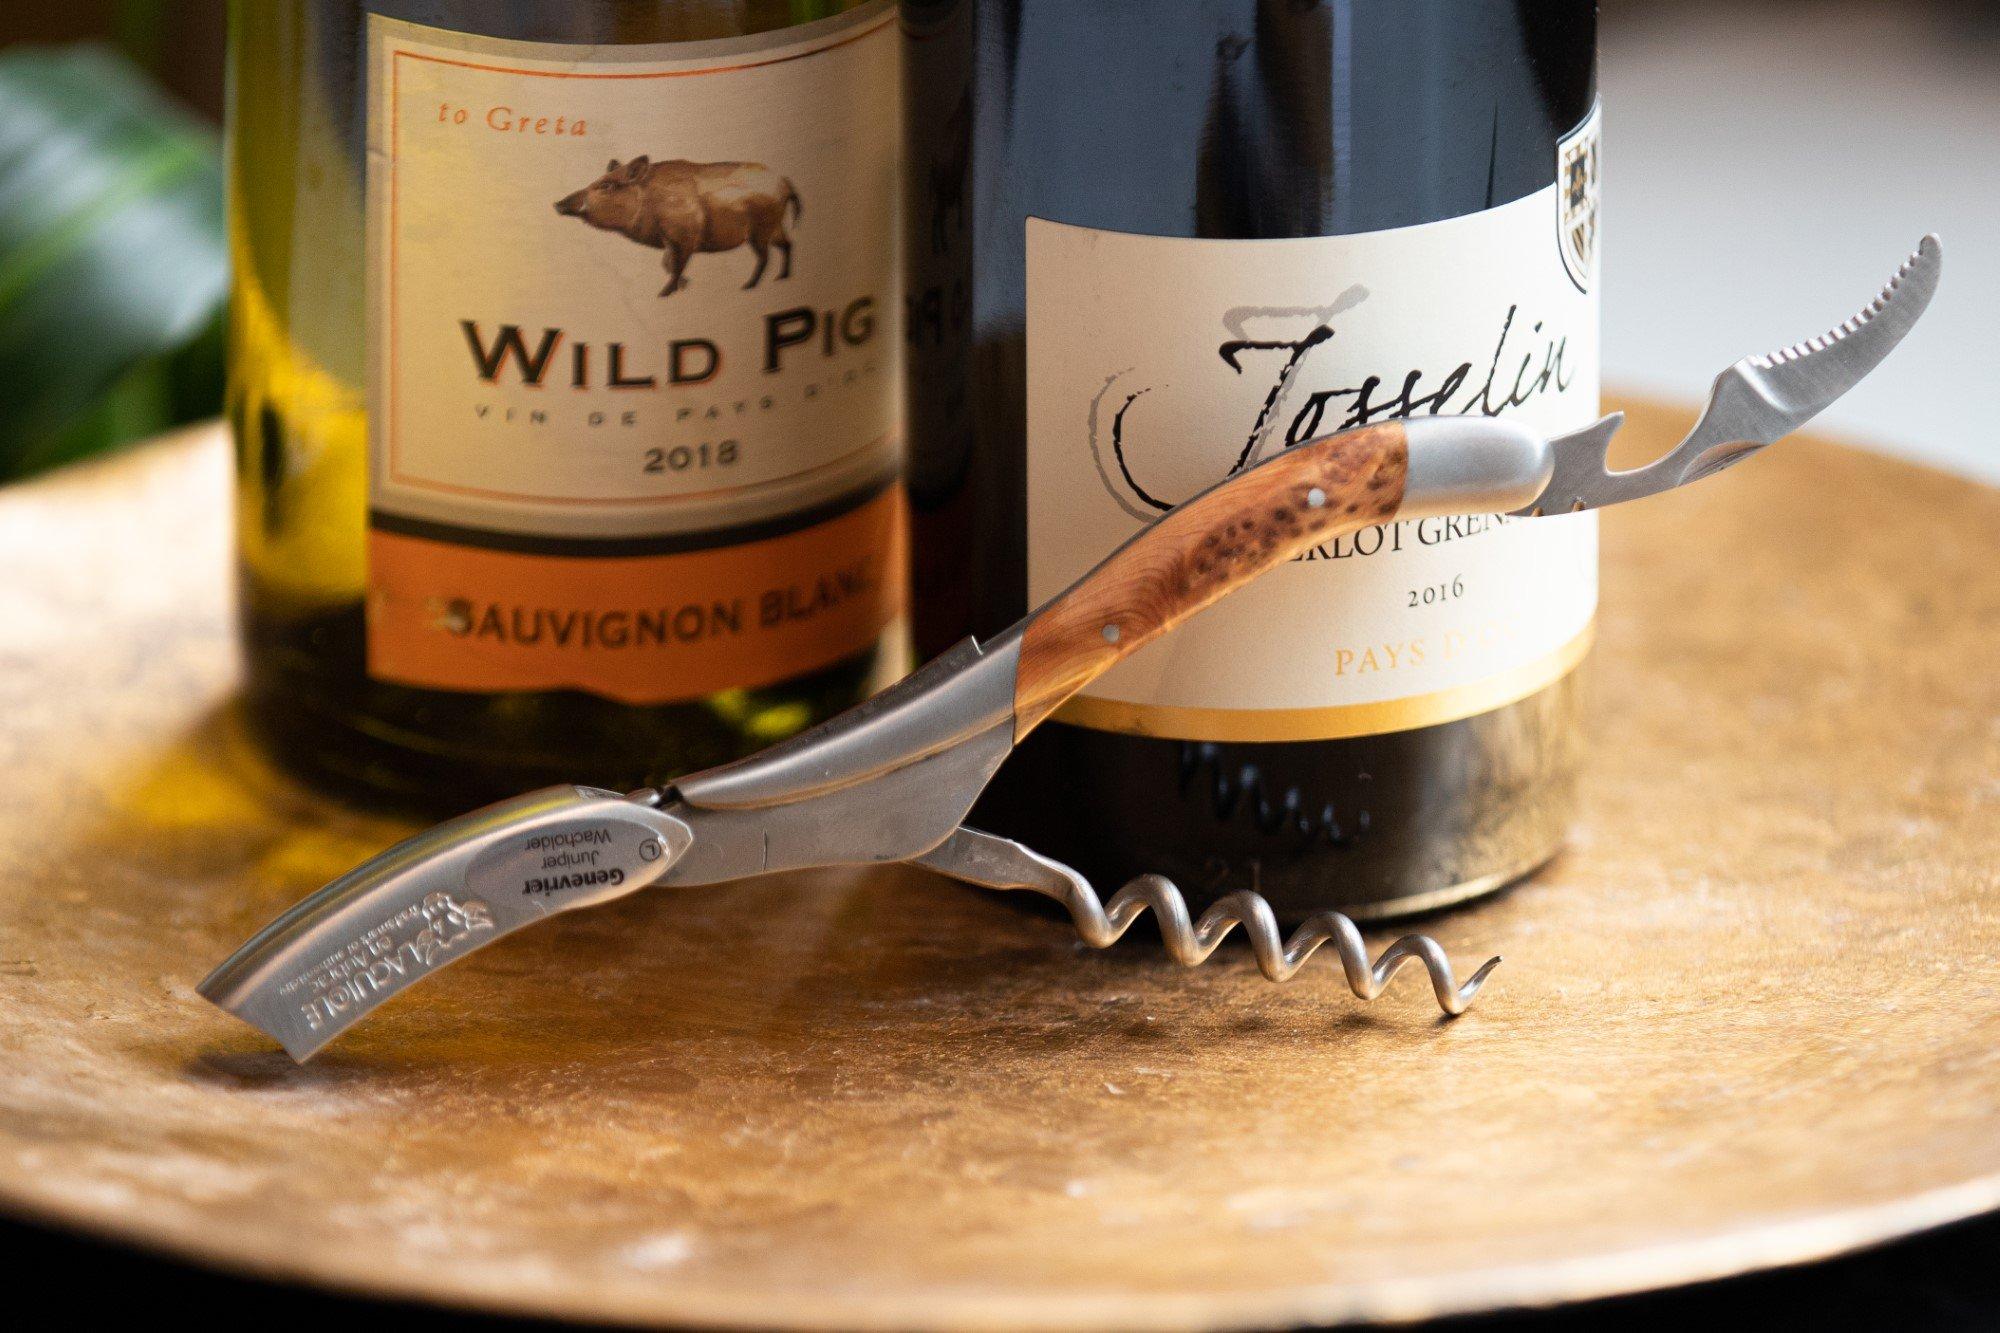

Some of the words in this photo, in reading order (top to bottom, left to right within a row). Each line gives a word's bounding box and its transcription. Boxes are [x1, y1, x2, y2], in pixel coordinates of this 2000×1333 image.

[439, 103, 467, 125] to
[486, 106, 587, 137] Greta
[643, 439, 740, 475] 2018
[1408, 573, 1464, 607] 2016
[447, 597, 741, 649] SAUVIGNON
[1335, 638, 1425, 676] PAYS
[525, 829, 612, 850] Wacholder
[541, 850, 599, 869] Juniper
[522, 868, 625, 896] Genevrier
